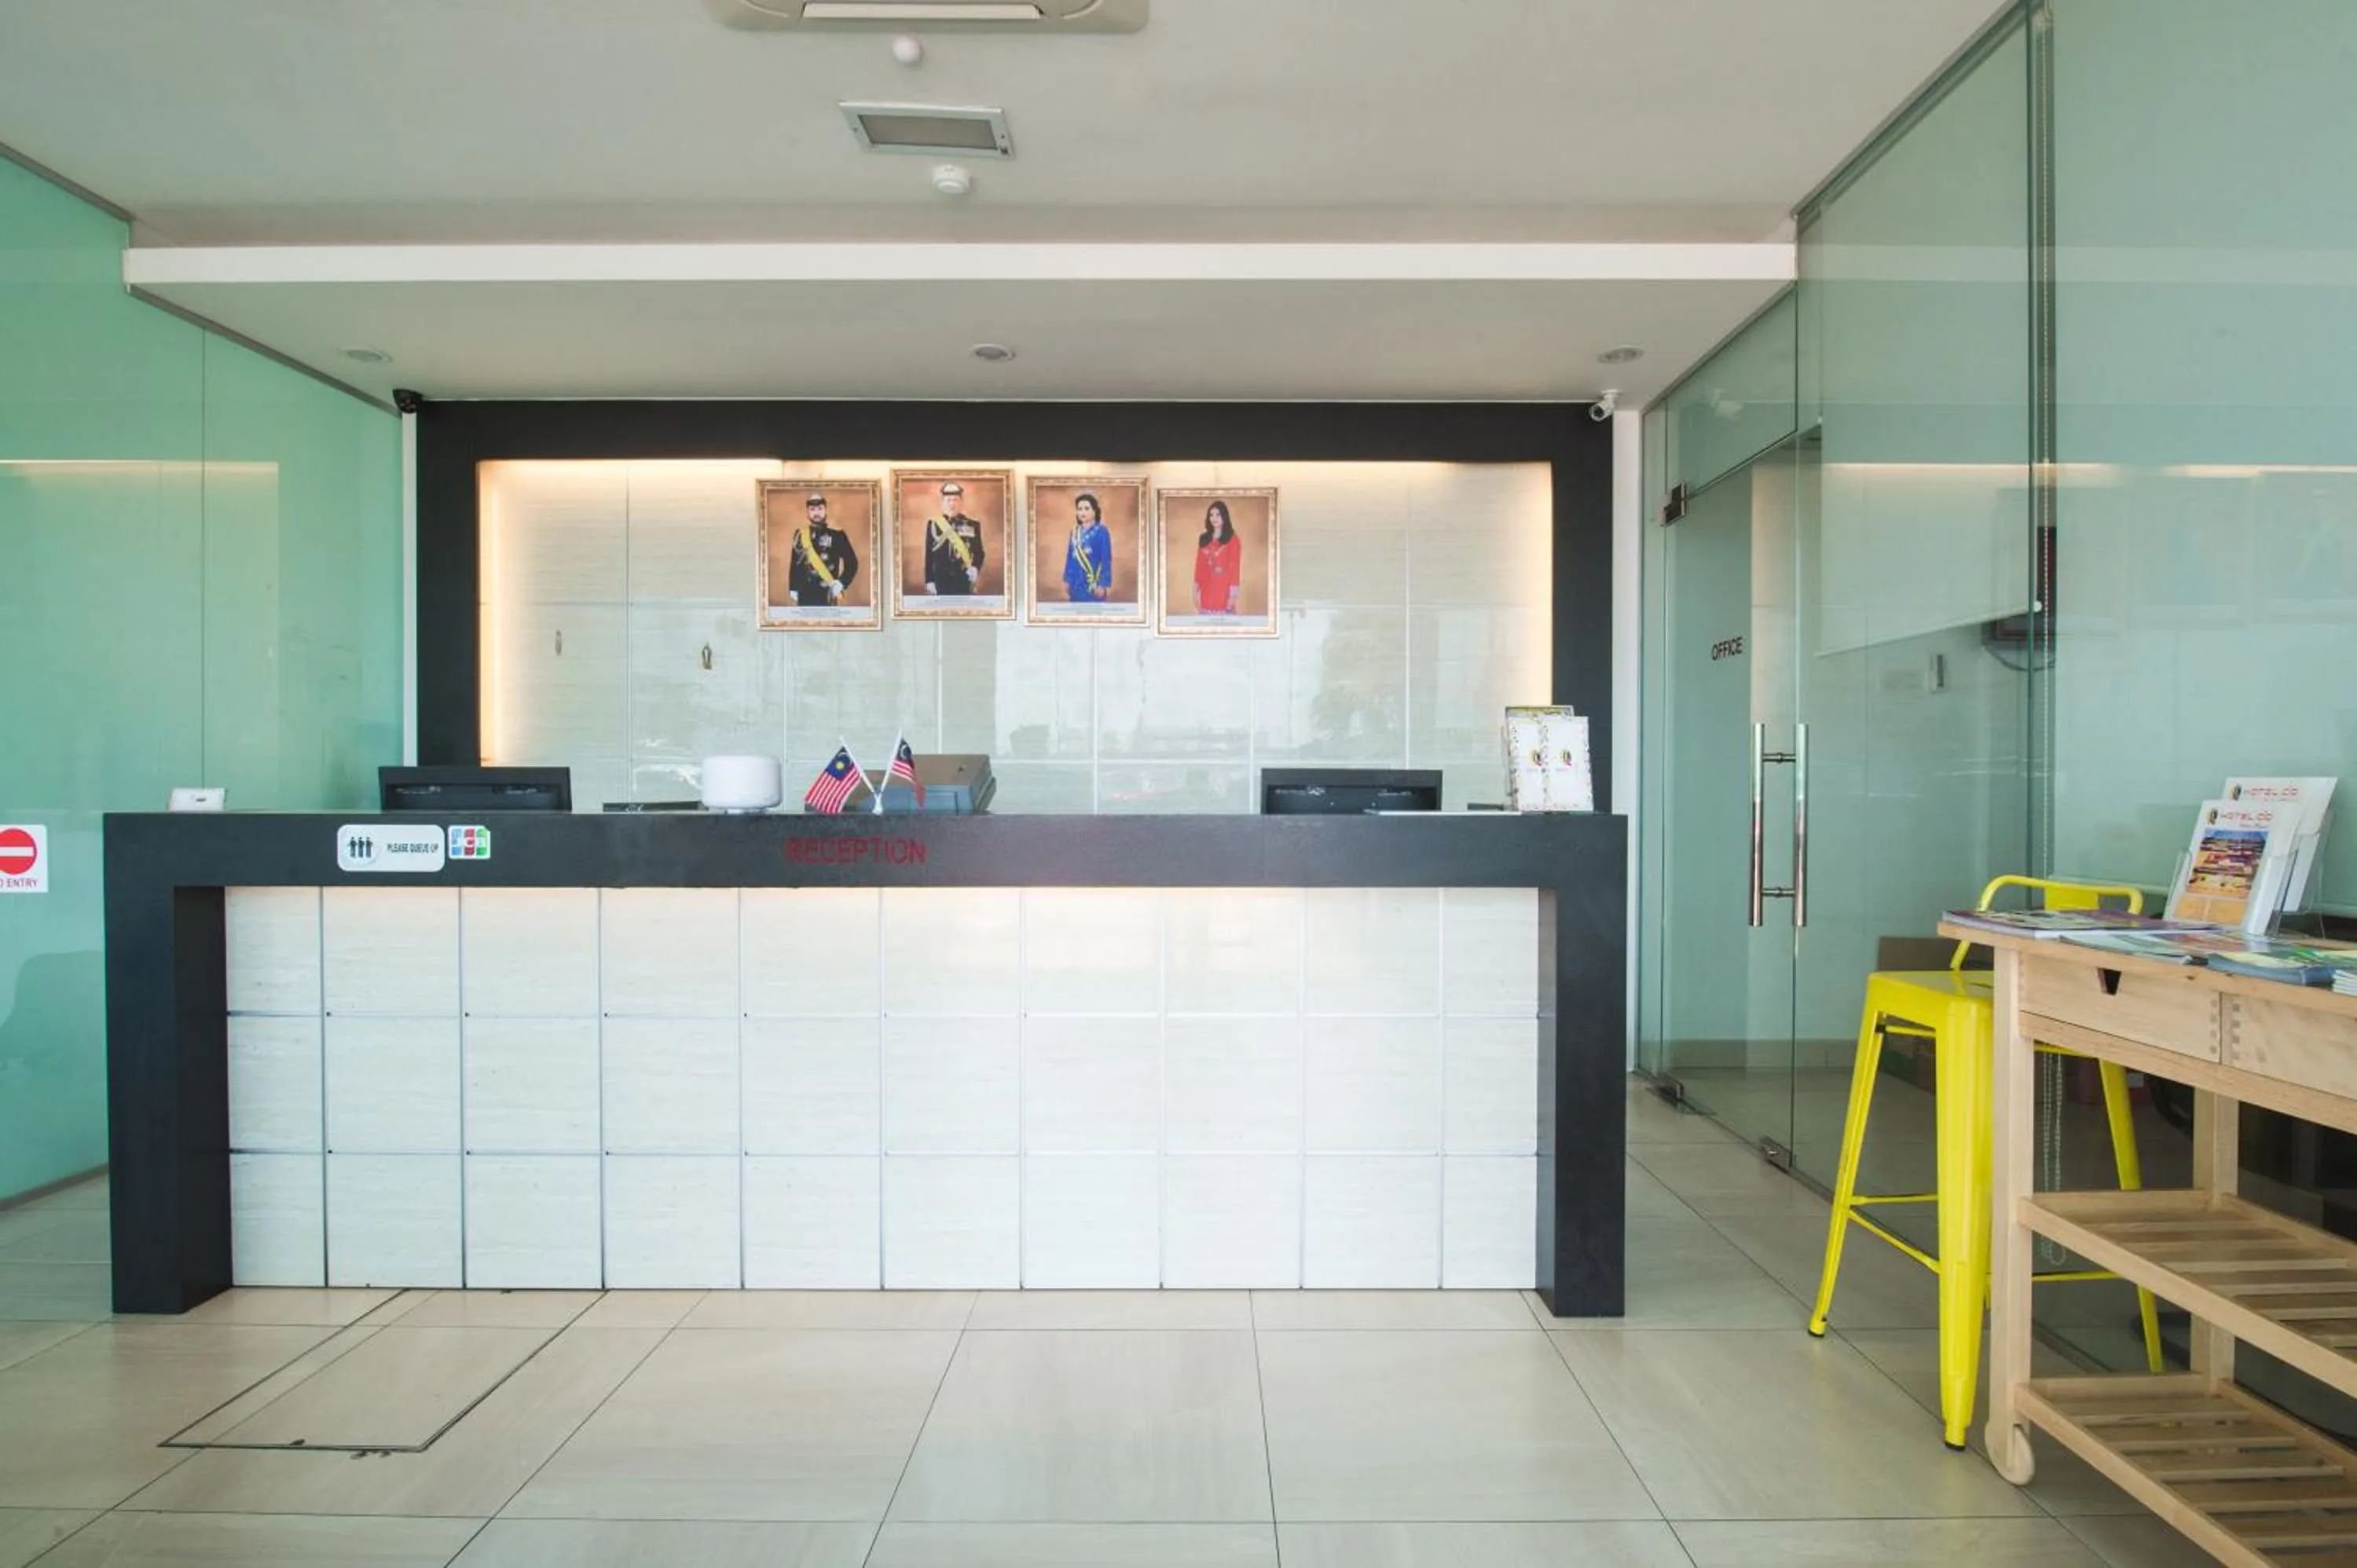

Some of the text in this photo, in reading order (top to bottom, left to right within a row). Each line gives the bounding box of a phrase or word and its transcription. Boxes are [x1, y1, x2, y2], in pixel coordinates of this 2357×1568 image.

[1711, 636, 1743, 661] OFFICE
[387, 843, 409, 852] PLEASE
[786, 837, 928, 864] RECEPTION
[7, 877, 38, 888] ENTRY
